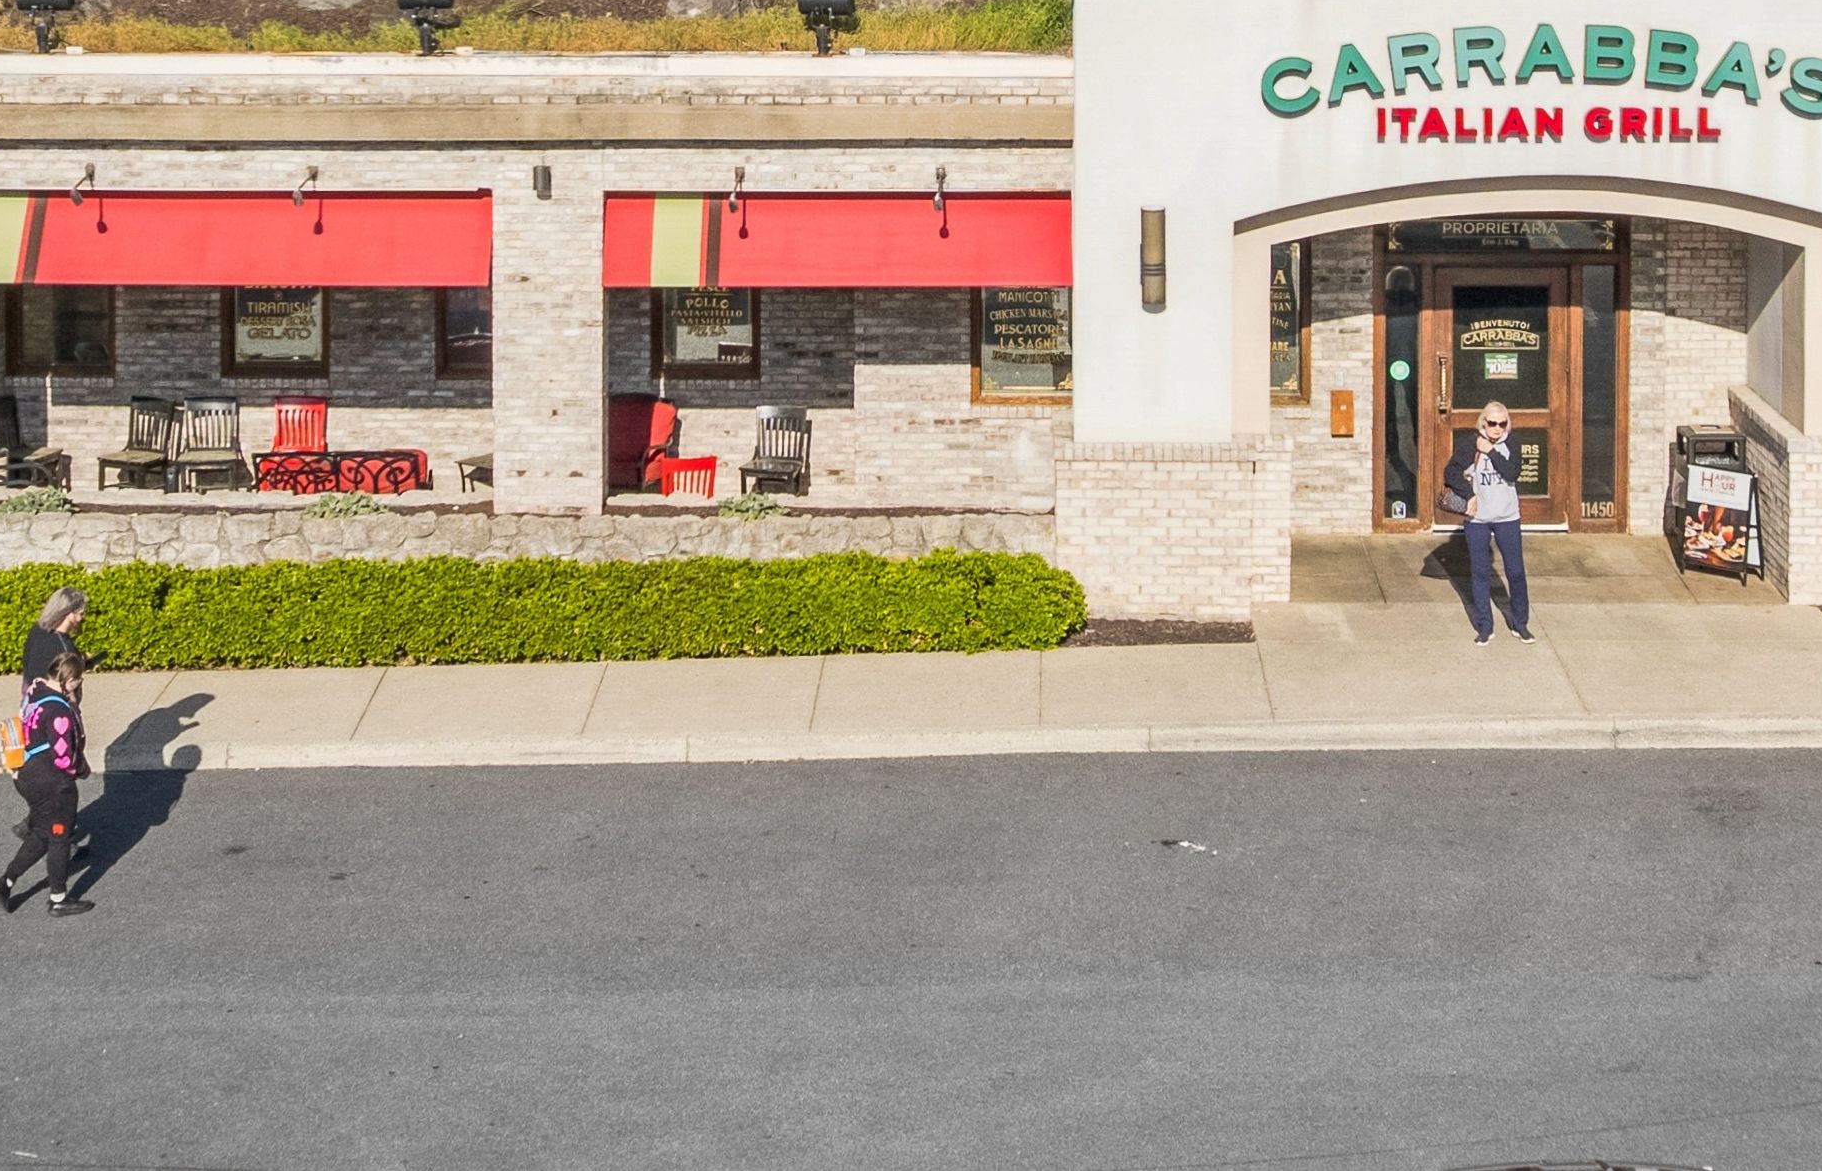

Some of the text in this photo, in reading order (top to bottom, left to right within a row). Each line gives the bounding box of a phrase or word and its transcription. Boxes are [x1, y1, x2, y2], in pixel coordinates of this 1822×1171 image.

[1376, 107, 1722, 143] ITALIAN GRILL
[1442, 221, 1559, 235] PROPRIETARIA
[685, 297, 730, 309] POLLO
[247, 327, 312, 340] GELATO
[1463, 329, 1537, 346] CARRABBA'S
[1580, 501, 1615, 518] 11450
